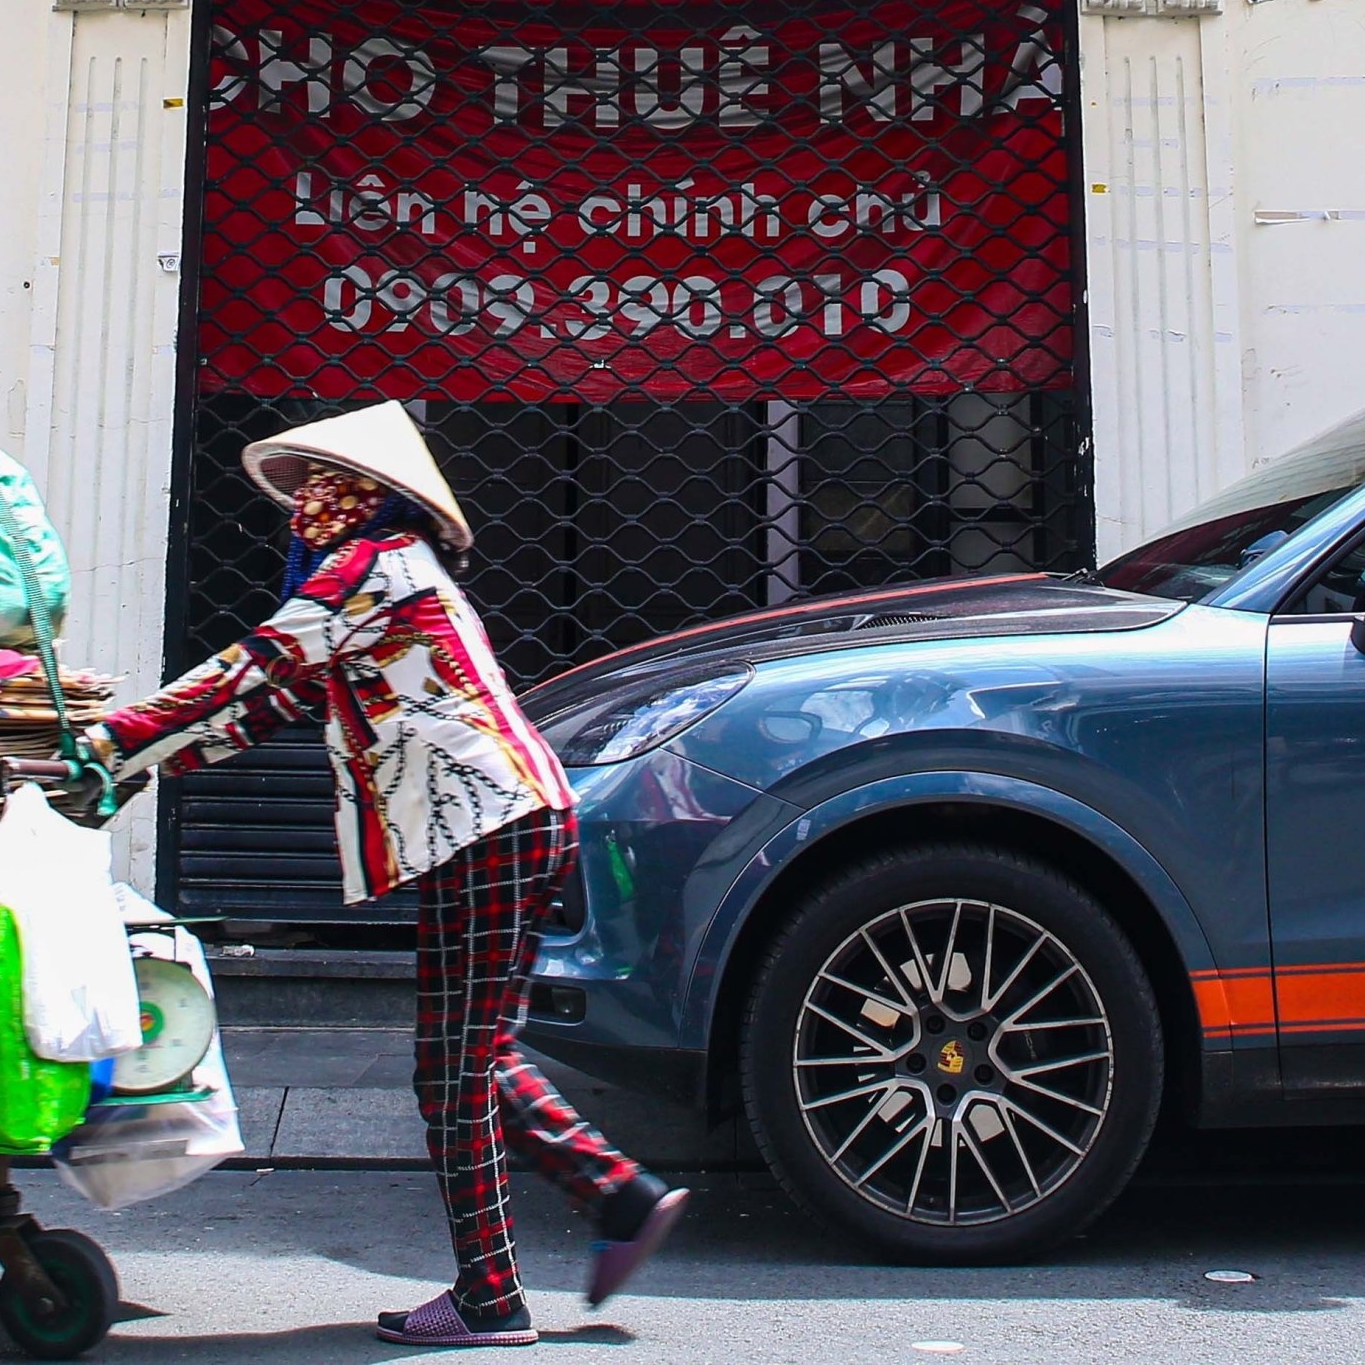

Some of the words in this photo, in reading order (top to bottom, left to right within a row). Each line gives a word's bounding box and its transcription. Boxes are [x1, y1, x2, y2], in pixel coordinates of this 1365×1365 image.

[478, 24, 770, 130] THUÊ
[818, 4, 1064, 123] NHÀ
[295, 172, 435, 235] Liên
[577, 178, 781, 237] chính
[323, 264, 911, 341] 0909.390.010
